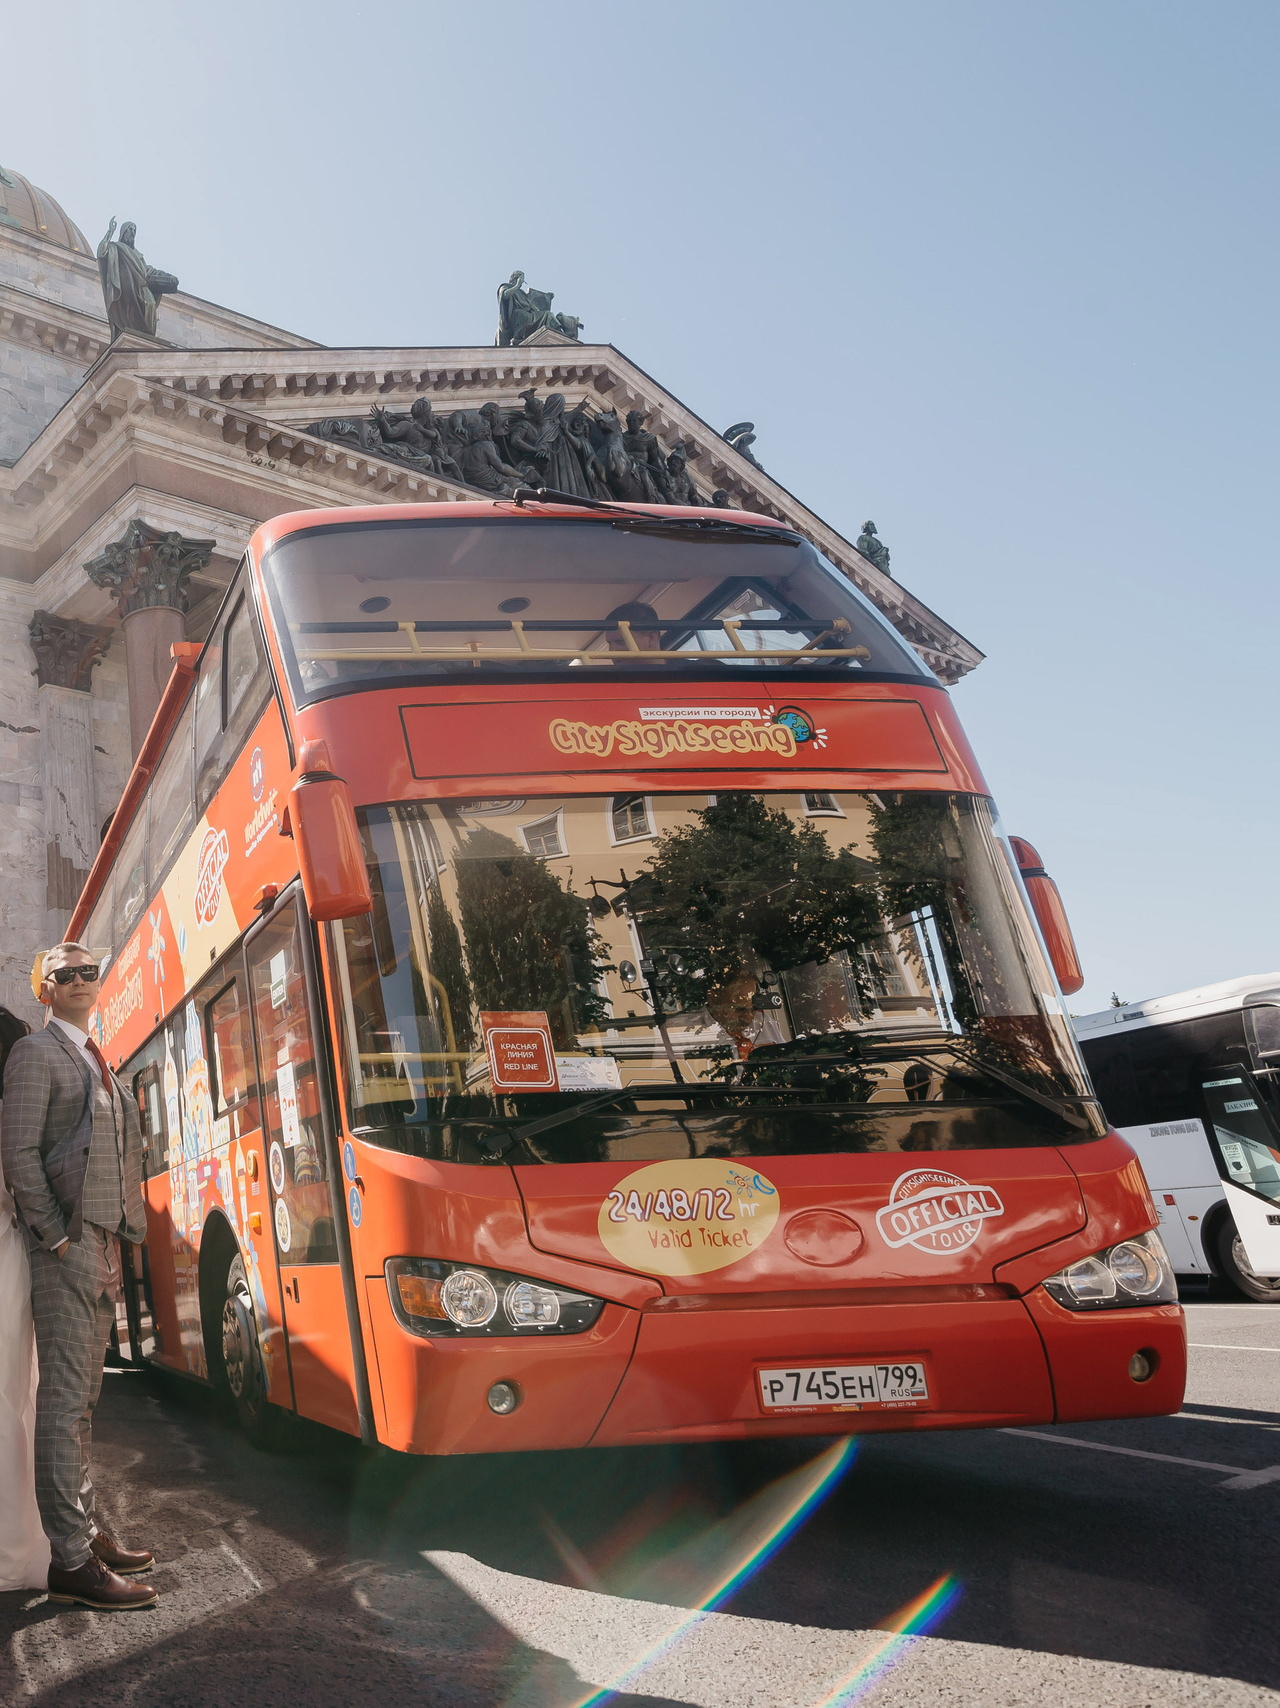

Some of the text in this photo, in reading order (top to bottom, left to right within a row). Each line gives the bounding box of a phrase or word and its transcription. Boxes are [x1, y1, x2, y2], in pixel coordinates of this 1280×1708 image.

[642, 709, 700, 718] экскурсии
[719, 710, 757, 718] городу
[197, 838, 227, 916] OFFICIAL
[1169, 1123, 1187, 1135] TONG
[1185, 1121, 1199, 1133] BUS
[898, 1173, 961, 1201] CITYSIGHTSEEING
[607, 1187, 760, 1223] 24/48/72 hr
[890, 1191, 996, 1236] OFFICIAL
[647, 1227, 753, 1249] Valid Ticket
[929, 1222, 977, 1248] TOUR
[877, 1365, 918, 1389] 799
[890, 1388, 911, 1398] RUS
